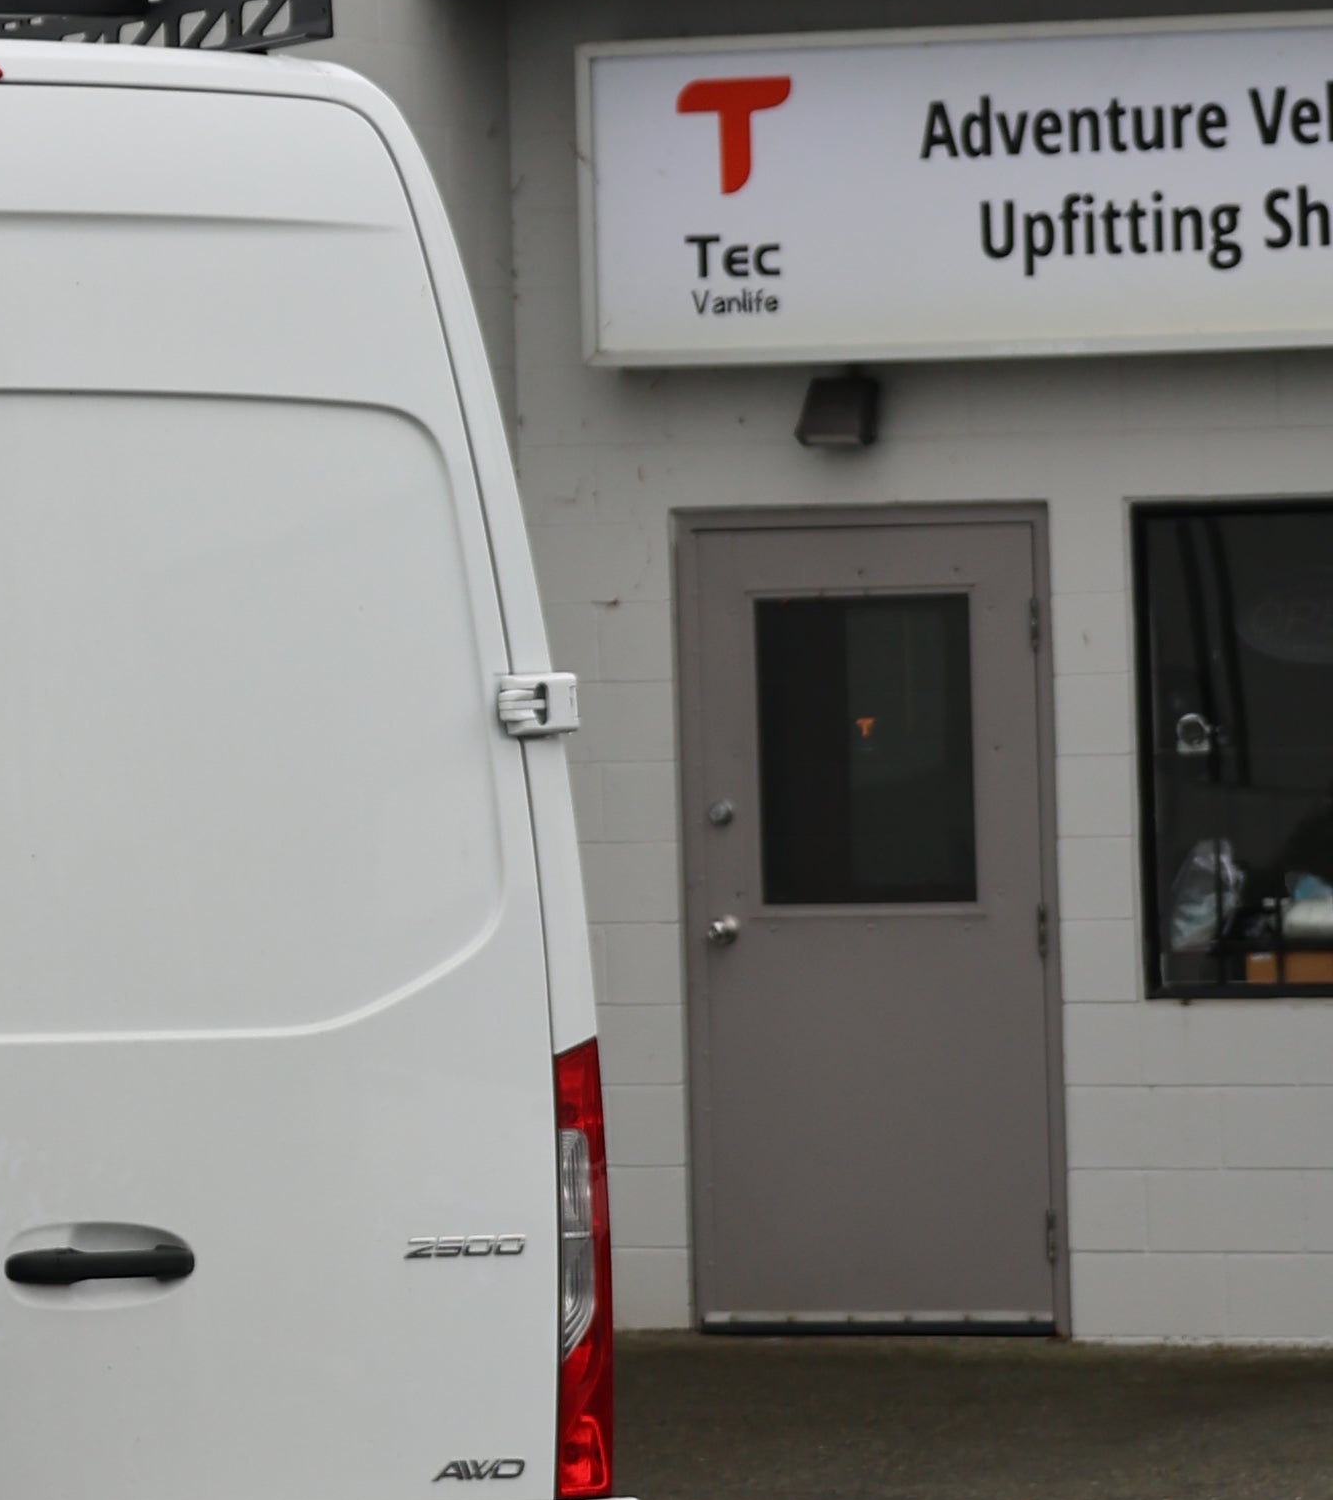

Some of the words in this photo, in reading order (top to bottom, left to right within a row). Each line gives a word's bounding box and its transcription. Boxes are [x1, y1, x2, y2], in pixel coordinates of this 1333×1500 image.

[920, 94, 1227, 159] Adventure
[1248, 80, 1333, 145] Ve
[981, 190, 1242, 276] Upfitting
[691, 288, 780, 316] Vanlife
[404, 1234, 526, 1259] 2500
[431, 1458, 525, 1481] AWD
